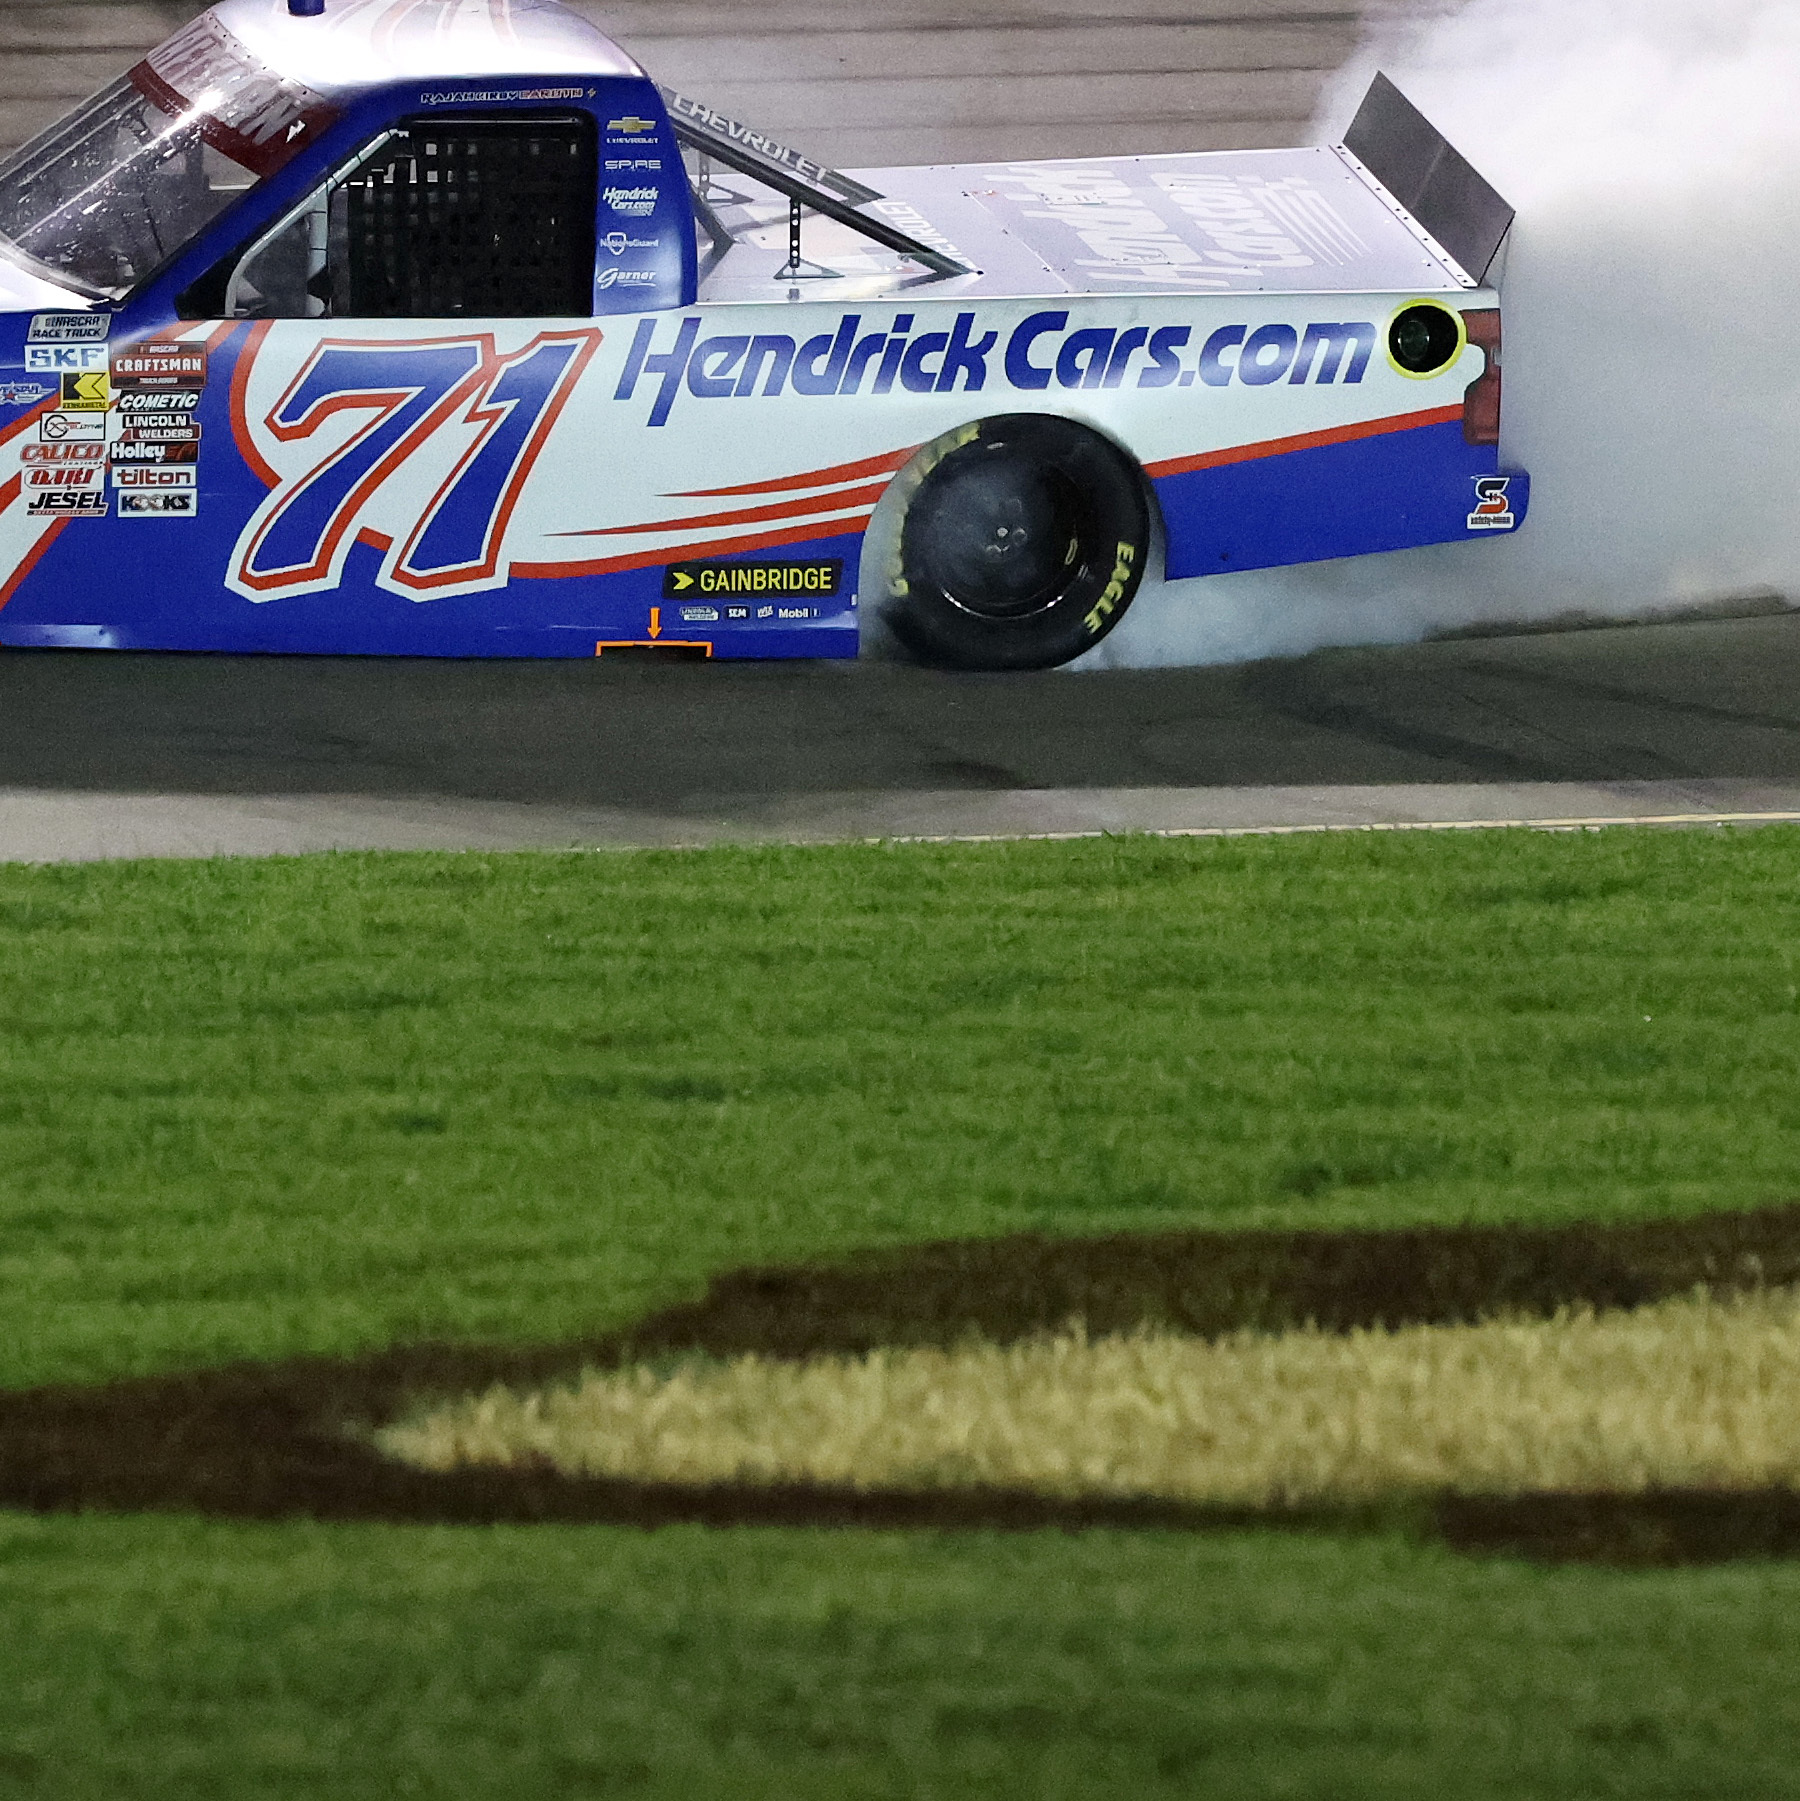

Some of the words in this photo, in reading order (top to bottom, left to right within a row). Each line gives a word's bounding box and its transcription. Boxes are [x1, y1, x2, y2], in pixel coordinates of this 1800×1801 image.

[674, 93, 827, 182] CHEVROLET
[603, 186, 659, 204] Hendrick
[55, 315, 100, 327] NASCAR
[32, 328, 61, 338] RACE
[65, 328, 101, 338] TRUCK
[29, 348, 102, 368] SKF
[115, 357, 202, 372] CRAFTSMAN
[613, 311, 1378, 428] HendrickCars.com
[119, 393, 199, 409] COMETIC
[124, 414, 187, 428] LINCOLN
[138, 428, 194, 439] WELDERS
[21, 443, 105, 462] CALICO
[111, 442, 166, 463] Holley
[224, 327, 604, 604] 71
[117, 469, 191, 486] tilton
[28, 491, 107, 510] JESEL
[700, 567, 833, 594] GAINBRIDGE
[778, 608, 809, 619] Mobil
